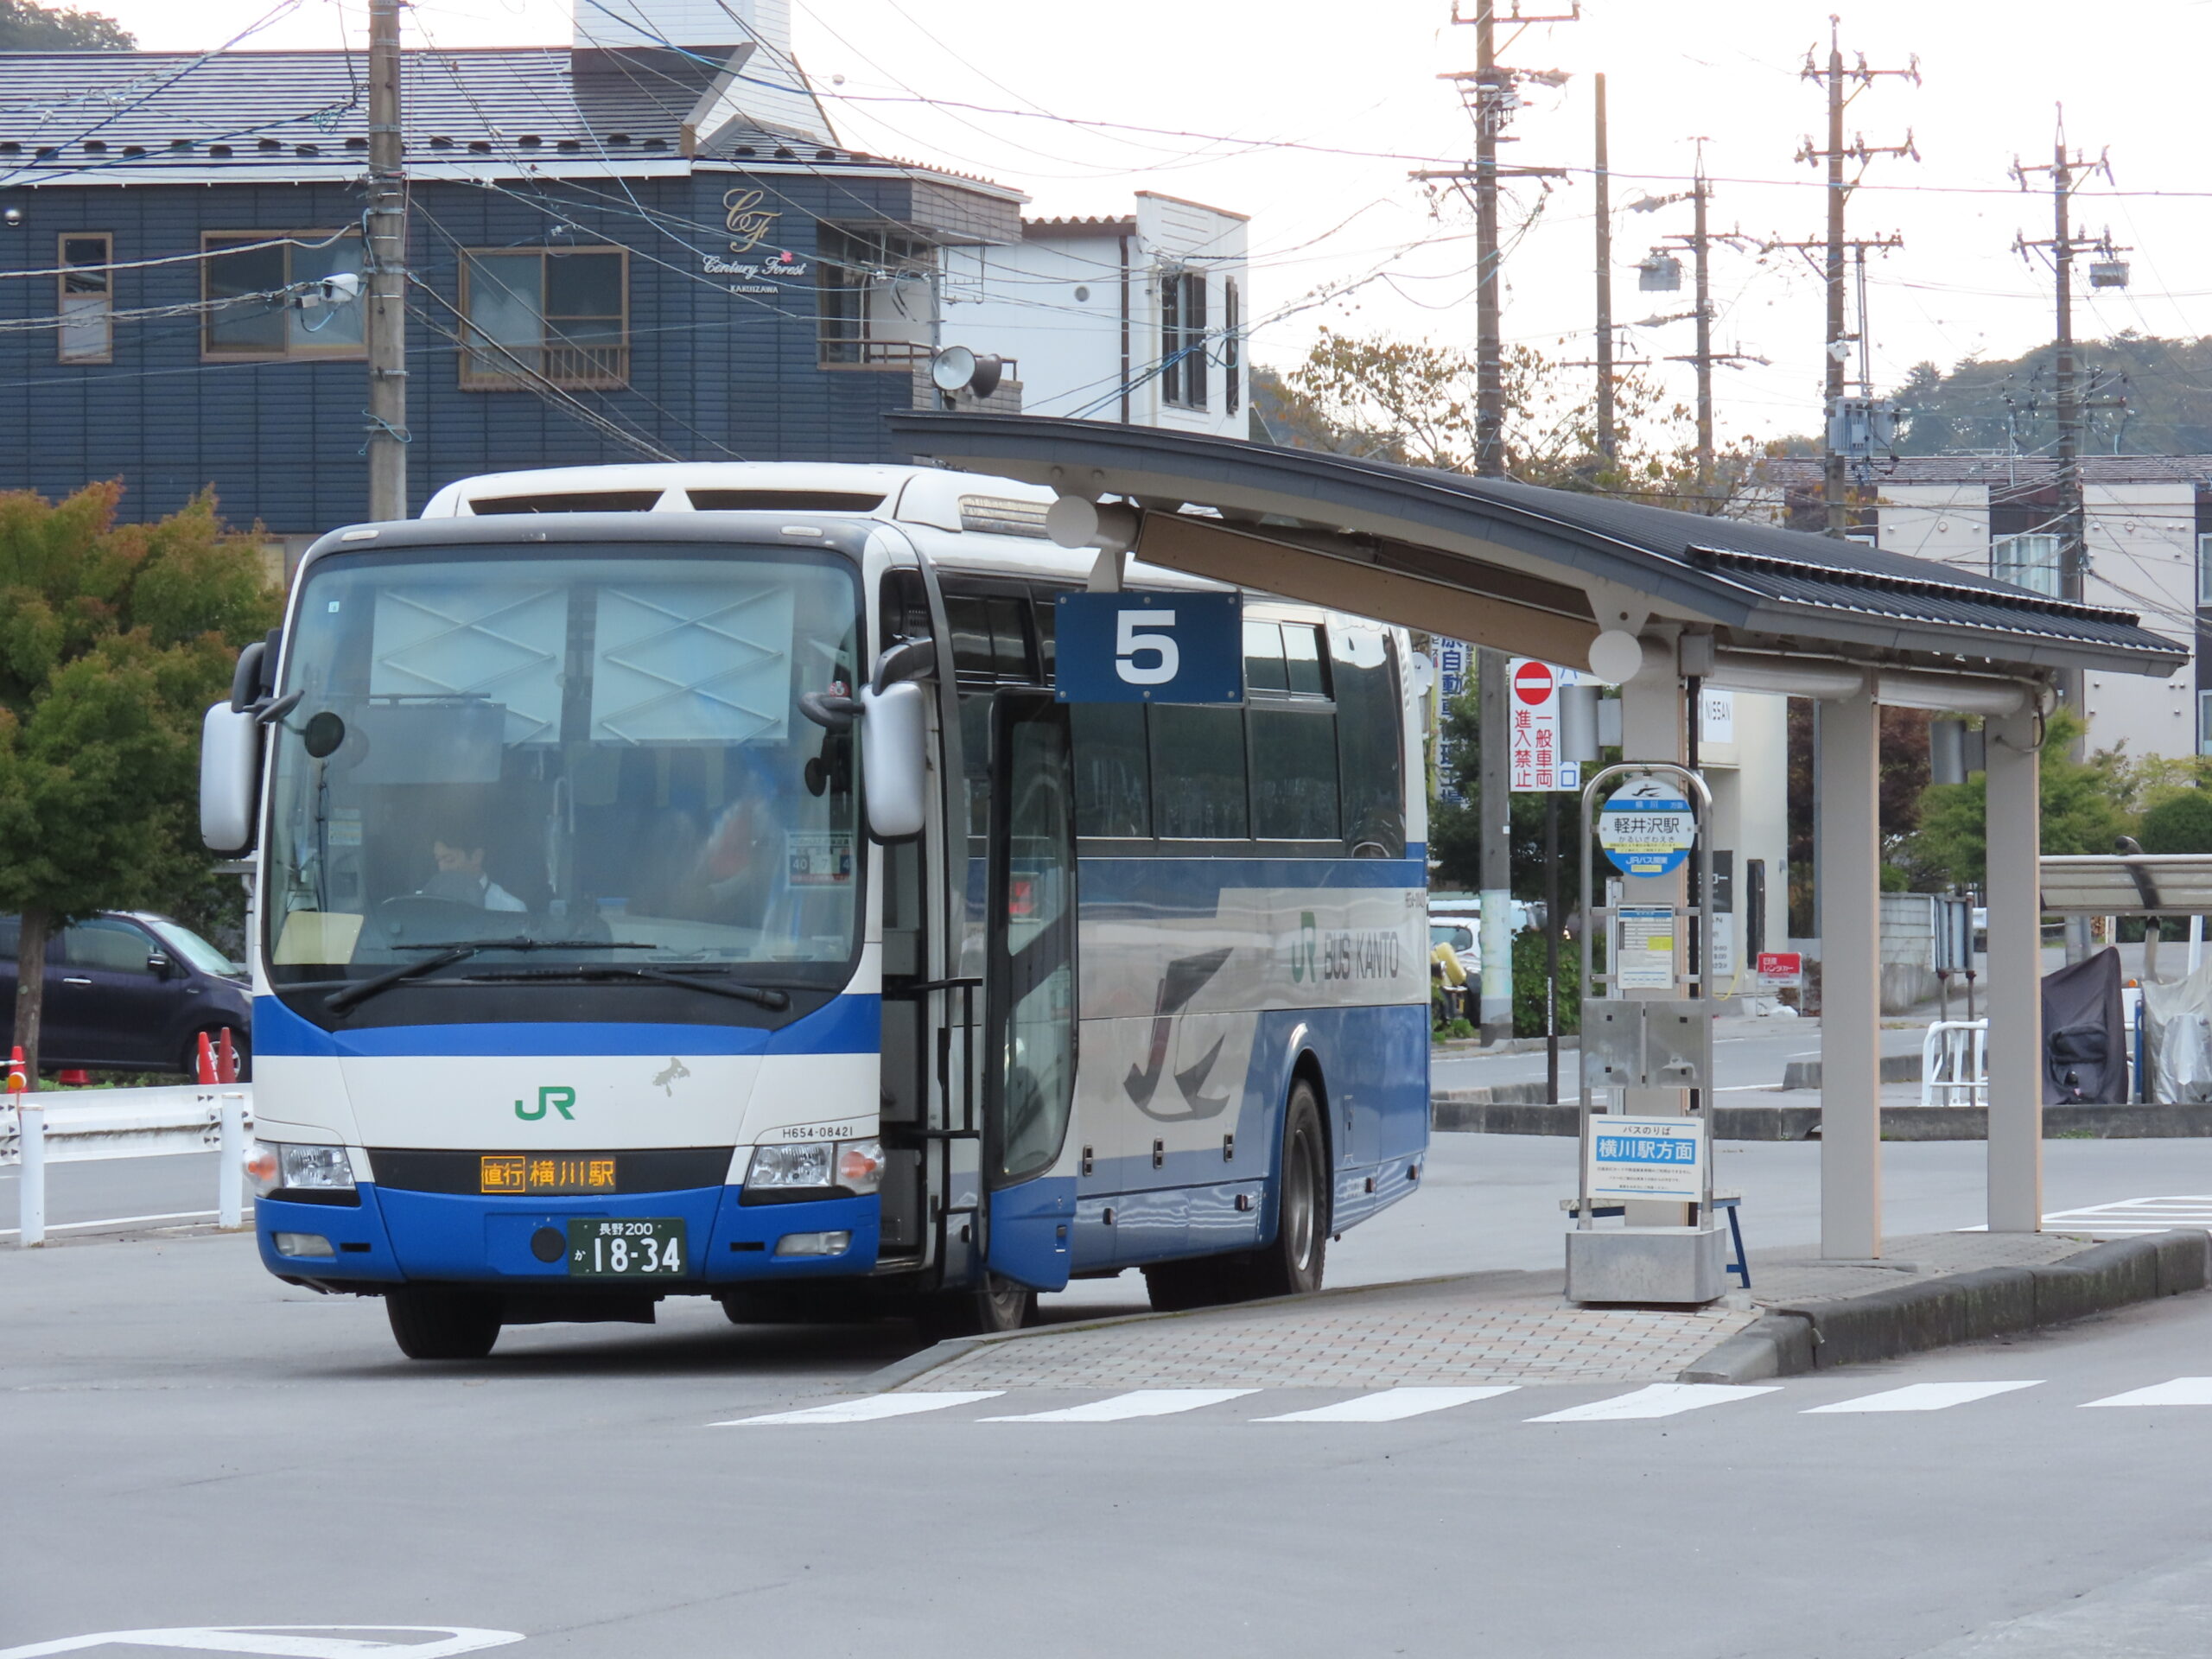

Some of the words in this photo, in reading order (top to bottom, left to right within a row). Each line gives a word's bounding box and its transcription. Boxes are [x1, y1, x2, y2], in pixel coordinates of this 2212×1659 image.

[702, 256, 759, 279] Century
[761, 257, 807, 276] Forest
[1116, 610, 1179, 685] 5
[1706, 701, 1731, 721] NISSAN
[1515, 709, 1532, 788] 進入禁止
[1535, 715, 1553, 788] 一般車両
[1614, 817, 1680, 834] 軽井沢駅
[1293, 912, 1316, 983] JR
[1324, 931, 1350, 980] BUS
[1357, 931, 1398, 979] KANTO
[515, 1086, 575, 1121] JR
[783, 1126, 853, 1139] H654-08421
[1623, 1126, 1672, 1136] バスのりば
[1599, 1138, 1693, 1161] 横川駅方面
[484, 1162, 524, 1186] 直行
[529, 1160, 614, 1187] 横川駅
[594, 1237, 680, 1273] 18-34
